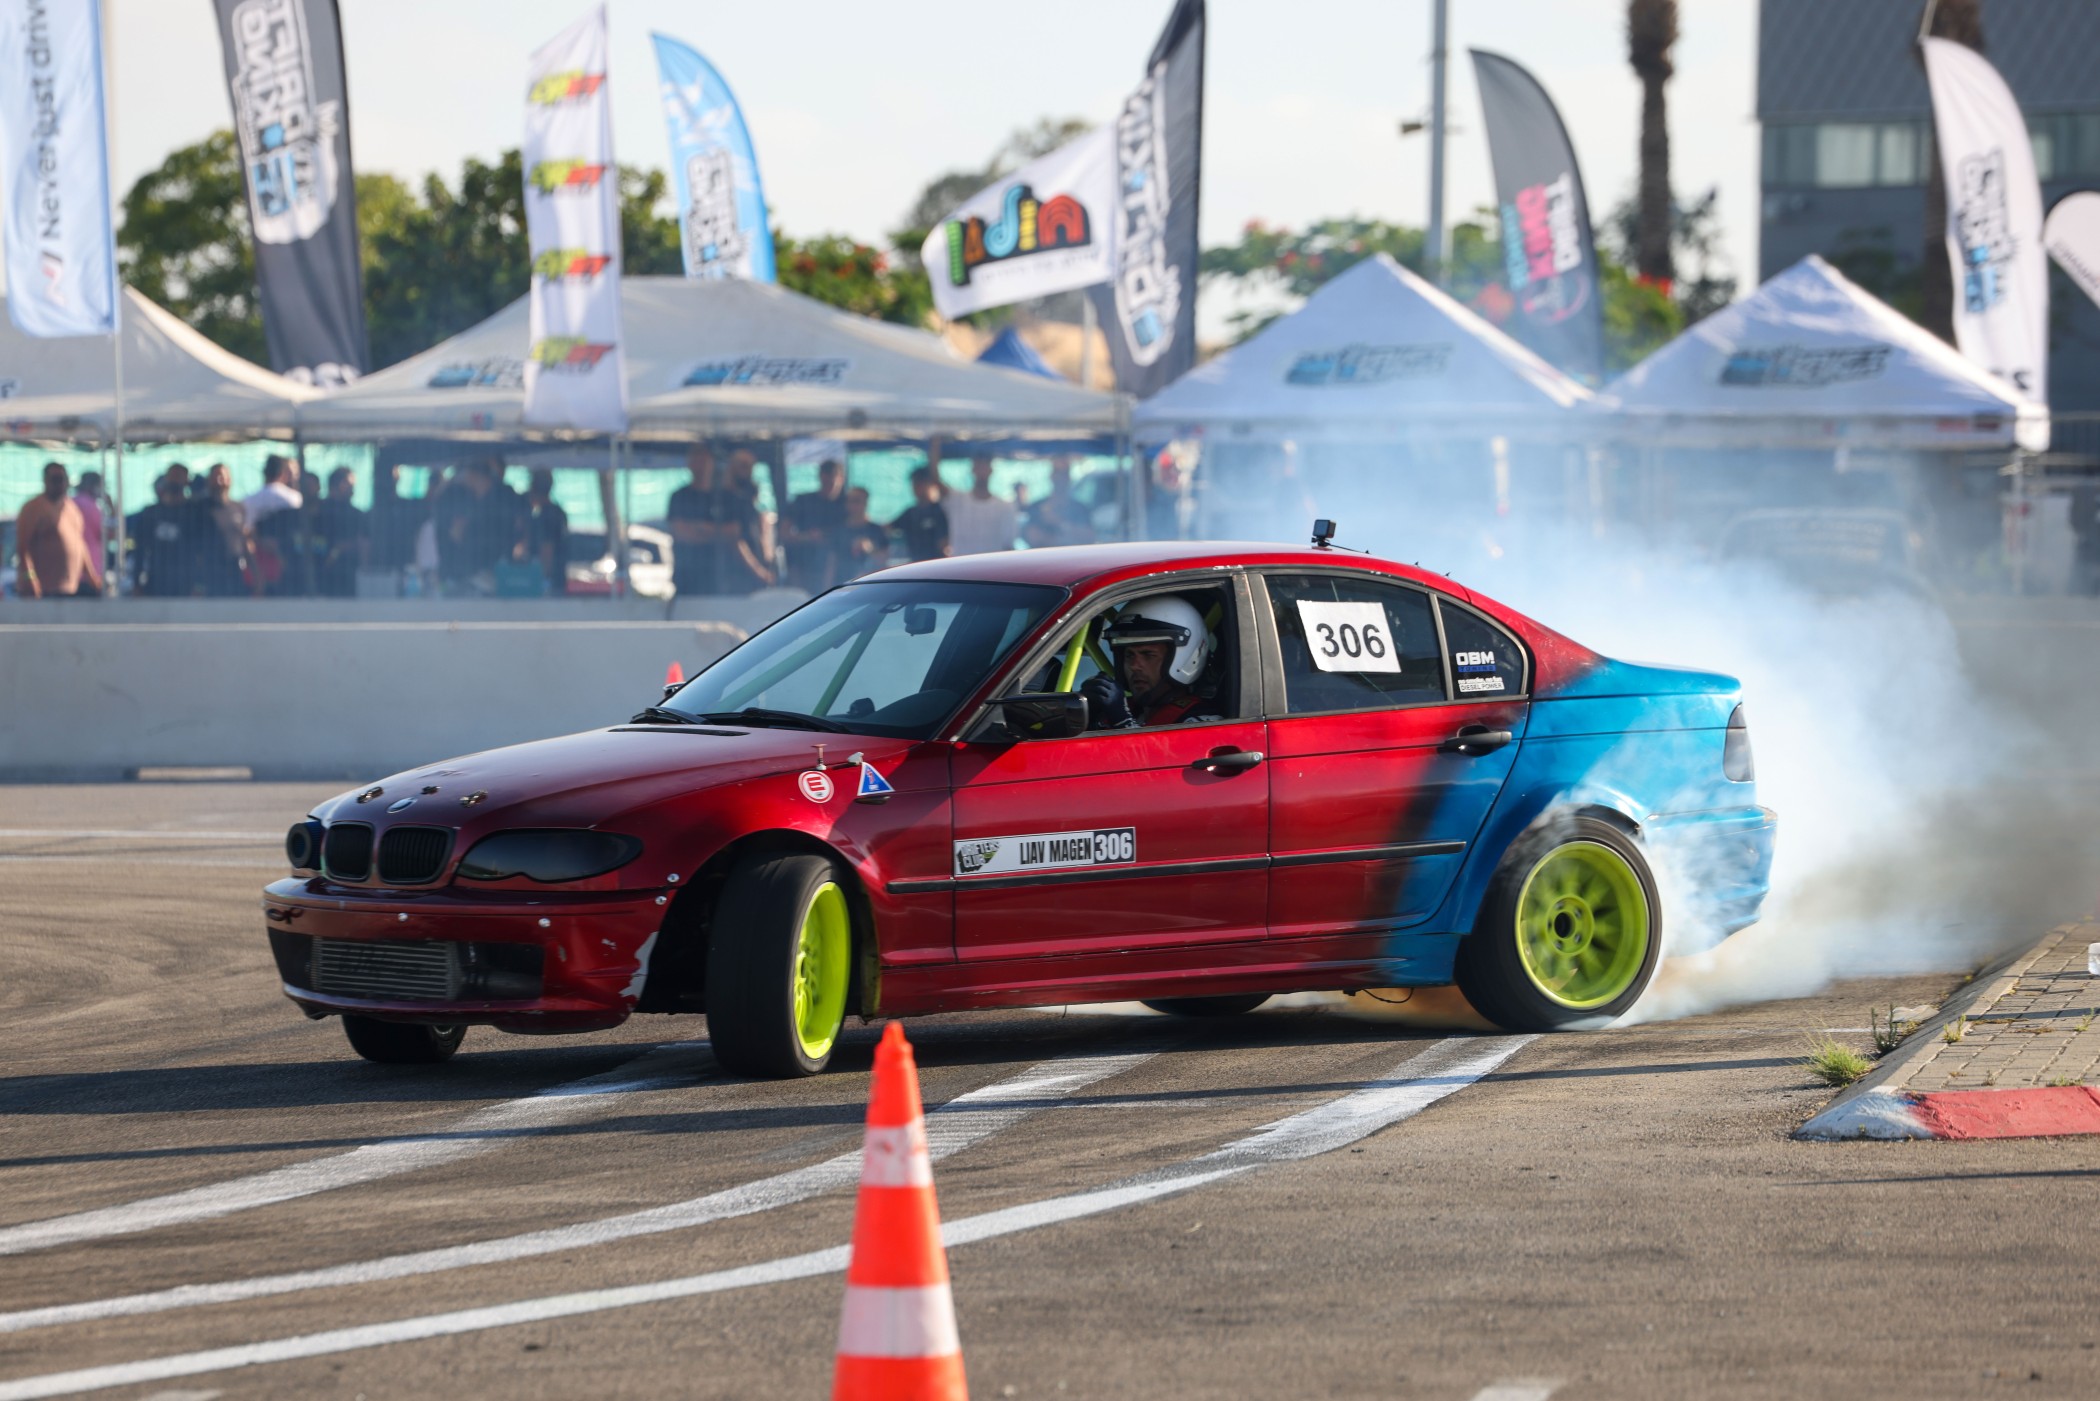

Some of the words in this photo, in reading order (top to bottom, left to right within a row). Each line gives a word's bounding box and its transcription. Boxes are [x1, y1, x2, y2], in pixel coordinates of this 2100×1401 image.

[22, 0, 52, 68] driv
[31, 77, 60, 138] just
[37, 145, 62, 240] Never
[1315, 623, 1386, 659] 306
[1456, 651, 1496, 665] OBM
[1019, 841, 1045, 865] LIAV
[1049, 837, 1092, 863] MAGEN
[1094, 832, 1133, 861] 306
